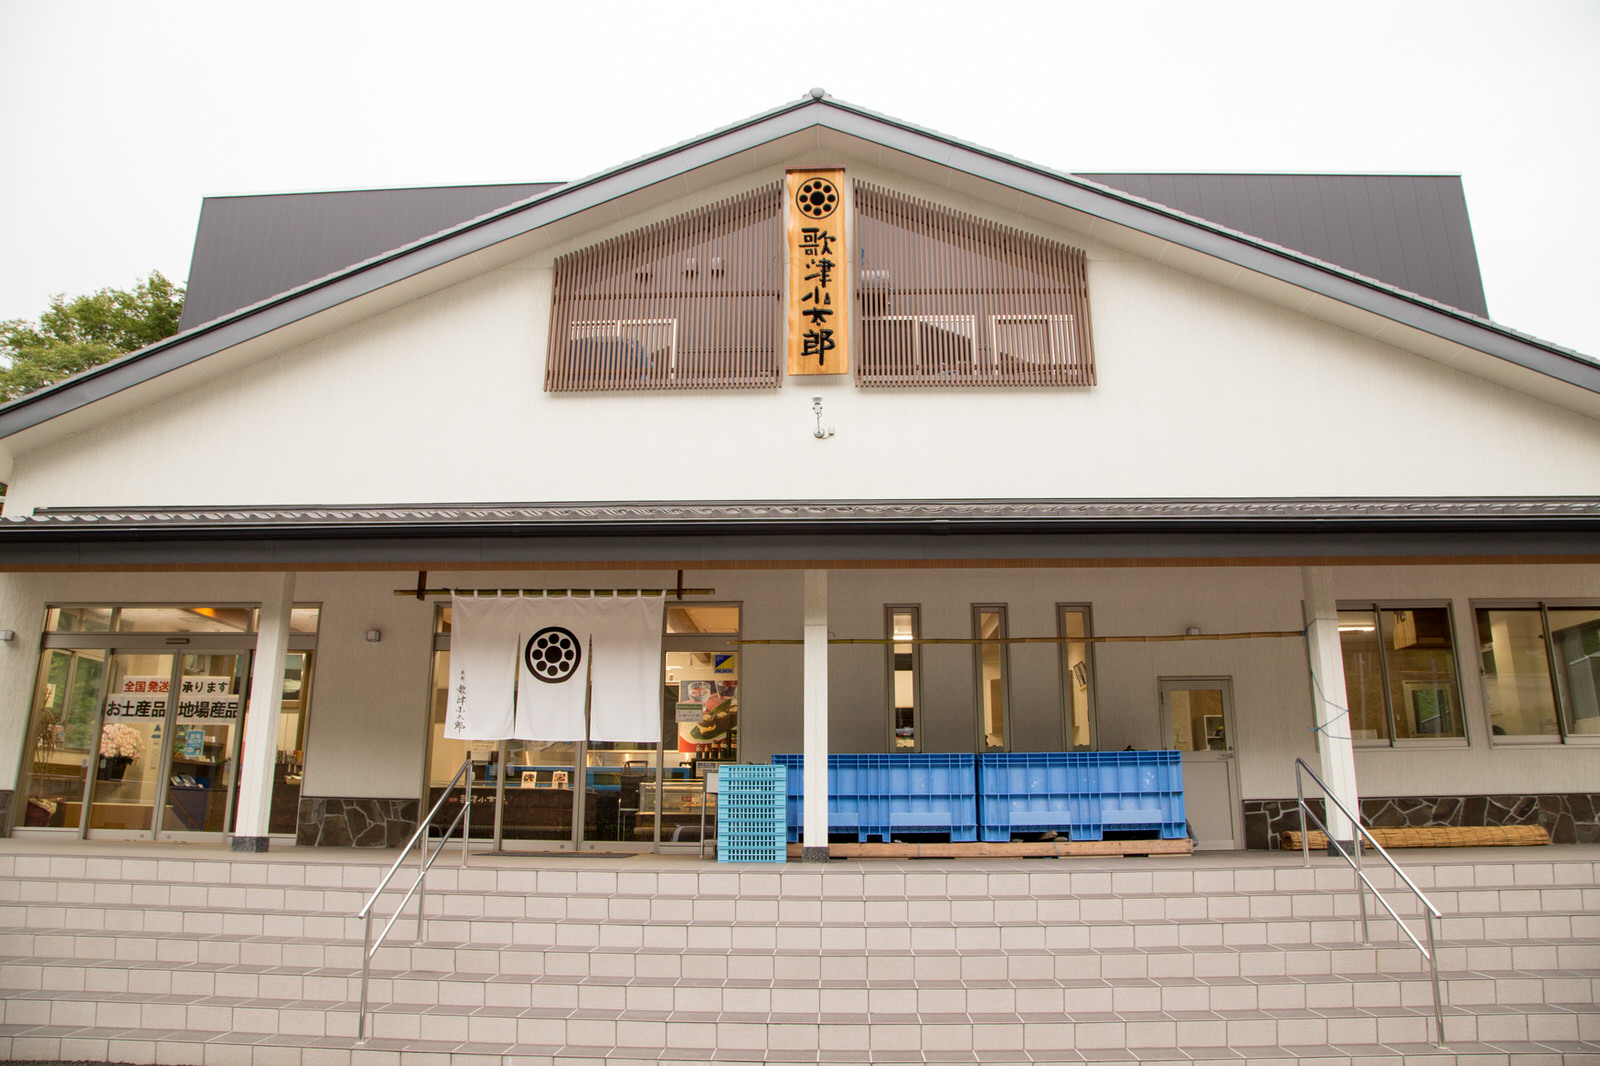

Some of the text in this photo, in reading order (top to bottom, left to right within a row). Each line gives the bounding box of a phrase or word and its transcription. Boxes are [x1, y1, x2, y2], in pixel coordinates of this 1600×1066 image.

[799, 227, 836, 366] 歌津小太郎
[123, 681, 228, 693] 全国発送 承ります
[106, 700, 239, 718] お土産品 地場産品
